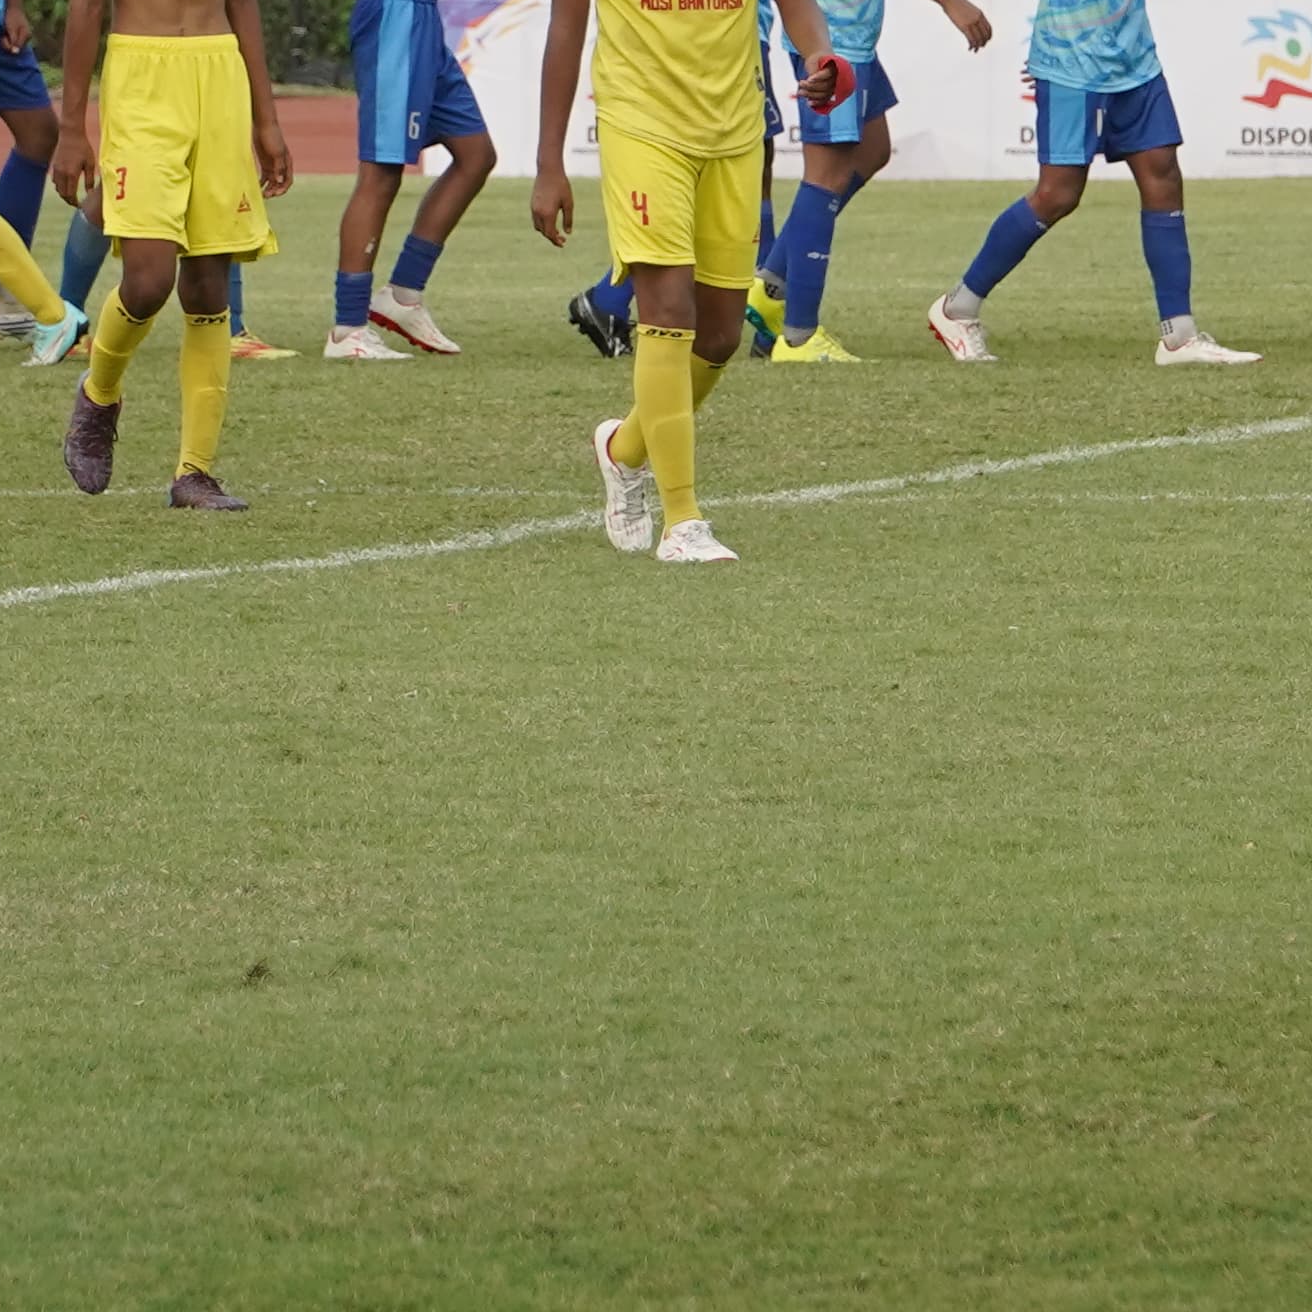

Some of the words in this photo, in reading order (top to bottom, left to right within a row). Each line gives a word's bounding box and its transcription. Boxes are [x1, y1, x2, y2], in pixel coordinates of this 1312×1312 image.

[409, 111, 422, 140] 6
[116, 167, 127, 200] 3
[631, 191, 649, 226] 4
